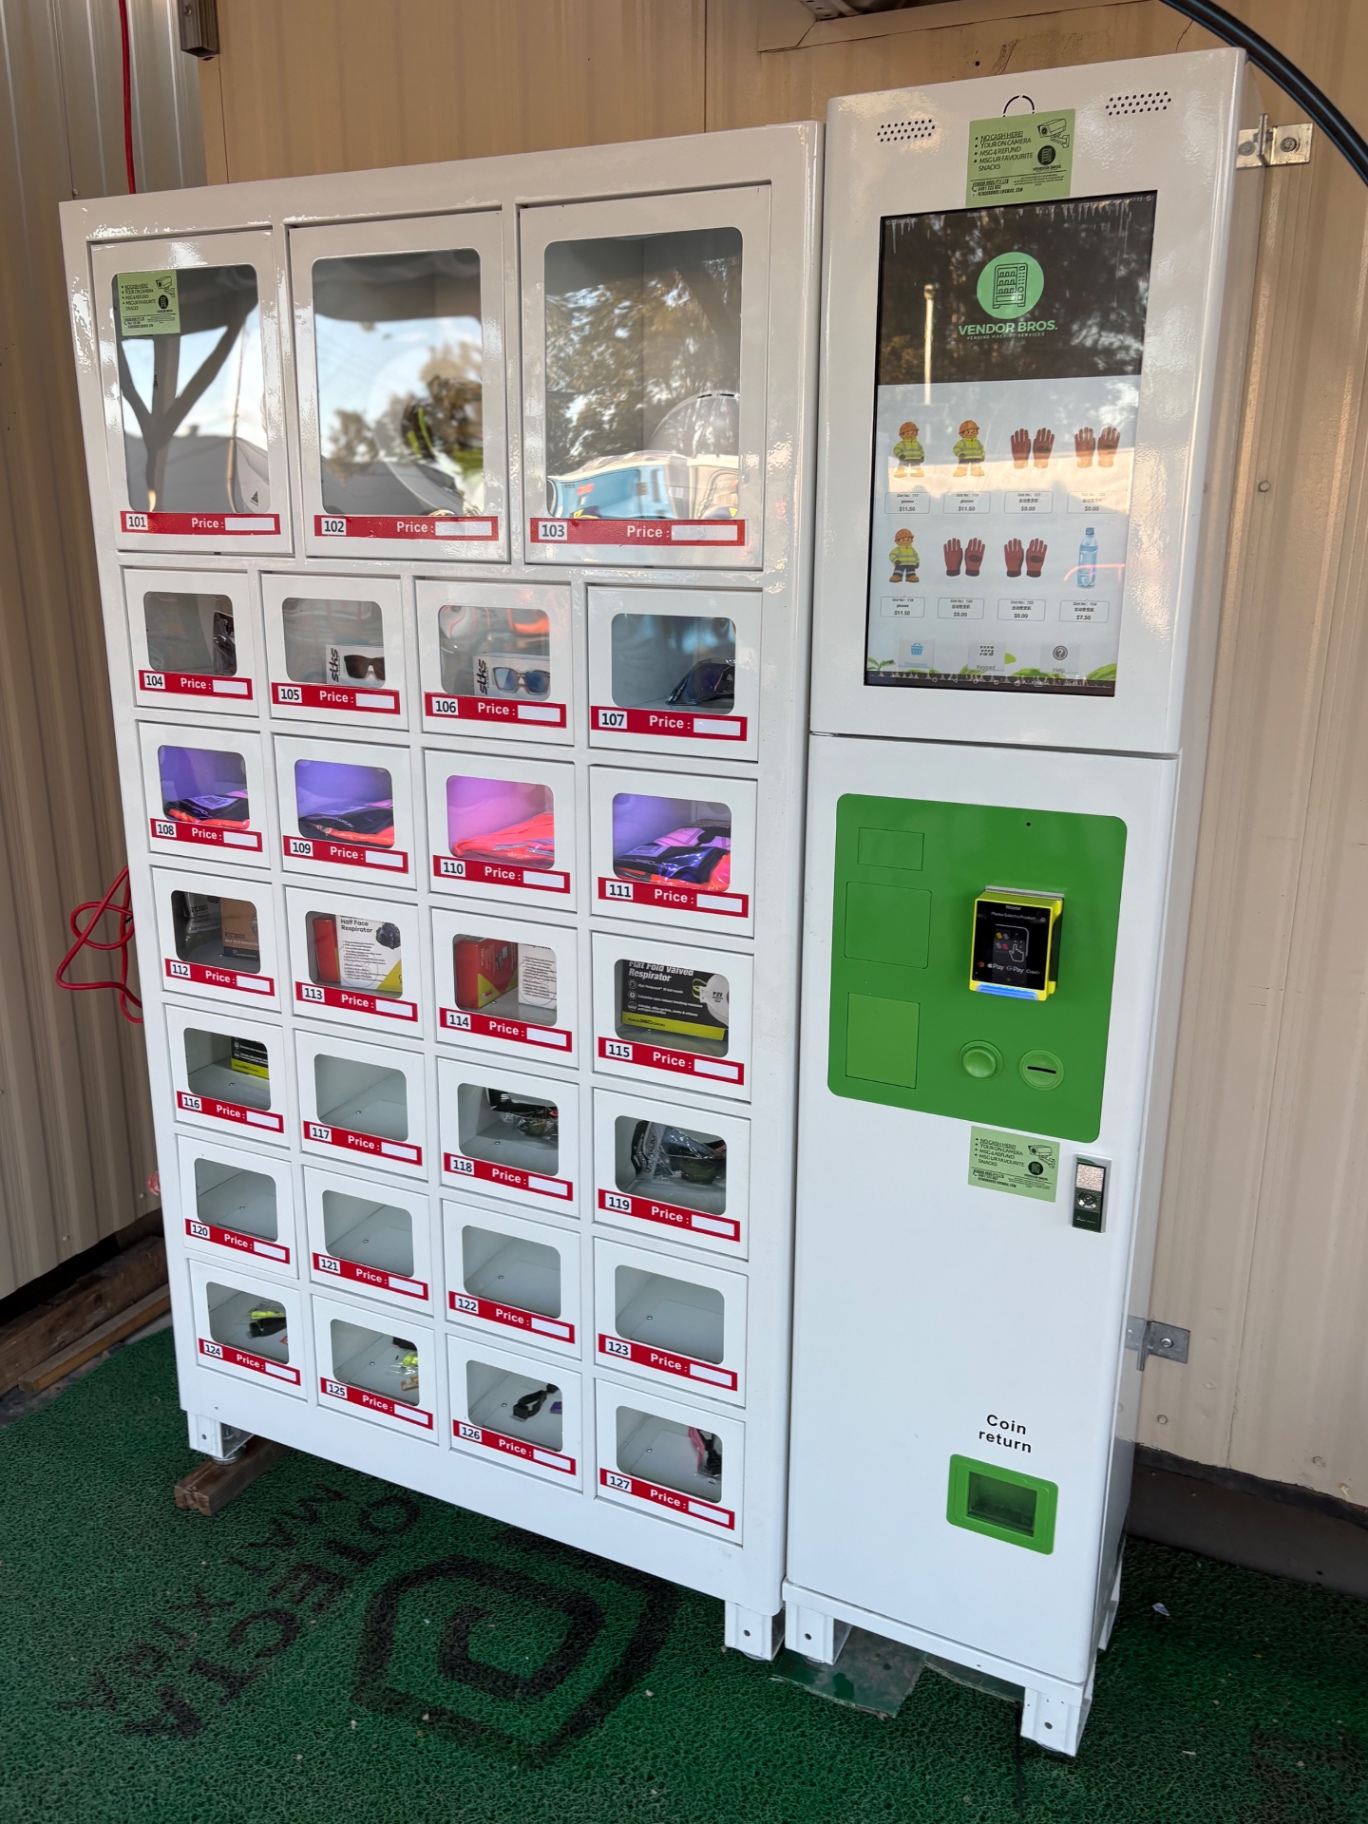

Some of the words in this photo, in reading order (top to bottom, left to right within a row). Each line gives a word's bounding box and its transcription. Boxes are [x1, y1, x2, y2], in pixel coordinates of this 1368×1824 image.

[1007, 138, 1032, 146] CAMERA
[998, 146, 1022, 154] REFUND
[1002, 152, 1034, 161] FAVOURITE
[978, 164, 1001, 172] SNACKS
[958, 322, 1015, 336] VENDOR
[1017, 320, 1058, 332] BROS.
[128, 516, 146, 528] 101
[324, 521, 344, 533] 102
[542, 524, 565, 538] 103
[976, 664, 996, 672] Keypad
[146, 676, 163, 686] 104
[281, 688, 299, 700] 105
[435, 700, 456, 713] 106
[602, 714, 624, 726] 107
[158, 824, 174, 836] 108
[292, 842, 311, 854] 109
[443, 862, 464, 875] 110
[609, 884, 632, 898] 111
[341, 925, 373, 933] Respirator
[172, 964, 188, 976] 112
[628, 960, 644, 969] Flat
[646, 962, 664, 972] Fold
[666, 966, 694, 976] Valved
[992, 963, 1004, 971] Pay
[628, 968, 672, 982] Respirator
[304, 988, 322, 1000] 113
[449, 1014, 470, 1027] 114
[608, 1044, 630, 1058] 115
[184, 1097, 200, 1109] 116
[312, 1127, 330, 1140] 117
[453, 1160, 472, 1173] 118
[608, 1196, 630, 1211] 119
[192, 1224, 208, 1237] 120
[321, 1258, 338, 1272] 121
[458, 1298, 478, 1313] 122
[205, 1344, 222, 1357] 124
[608, 1342, 629, 1356] 123
[328, 1384, 346, 1398] 125
[986, 1414, 1026, 1435] Coin
[462, 1426, 481, 1440] 126
[979, 1430, 1032, 1453] return
[610, 1476, 631, 1490] 127
